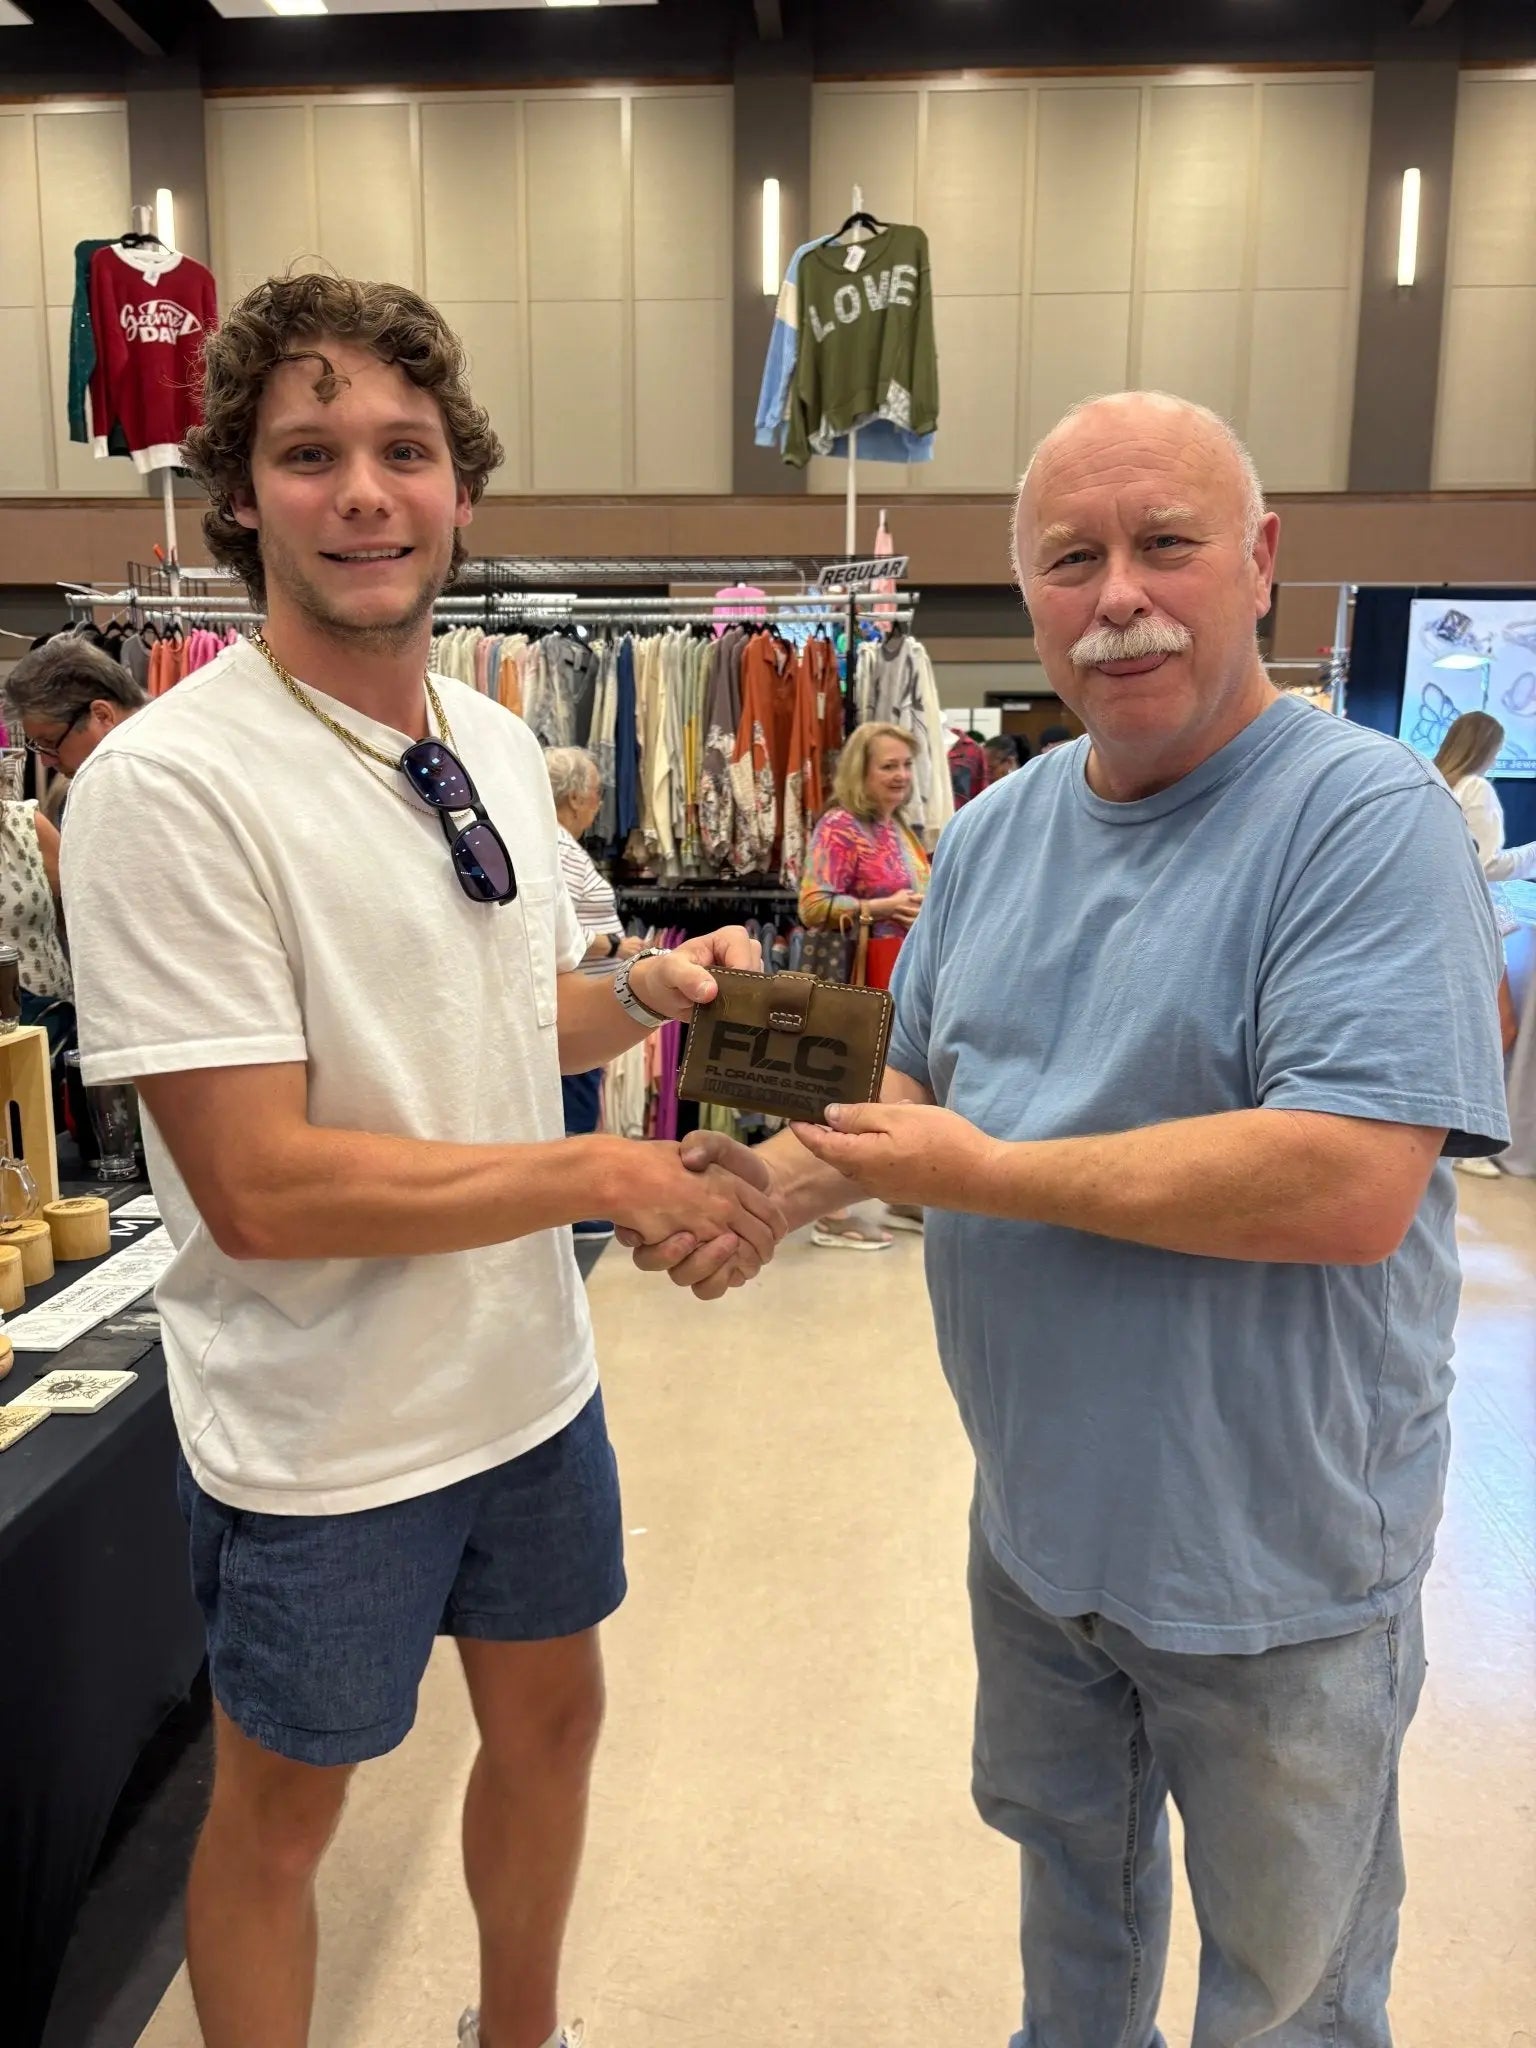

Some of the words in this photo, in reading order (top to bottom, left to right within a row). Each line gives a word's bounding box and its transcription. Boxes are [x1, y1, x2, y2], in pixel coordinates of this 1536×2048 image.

[809, 264, 918, 343] LOVE
[139, 326, 178, 345] DAY
[822, 560, 902, 586] REGULAR
[709, 1020, 848, 1082] FLC
[705, 1064, 723, 1077] FL
[723, 1067, 779, 1087] CRANE
[780, 1078, 793, 1089] &
